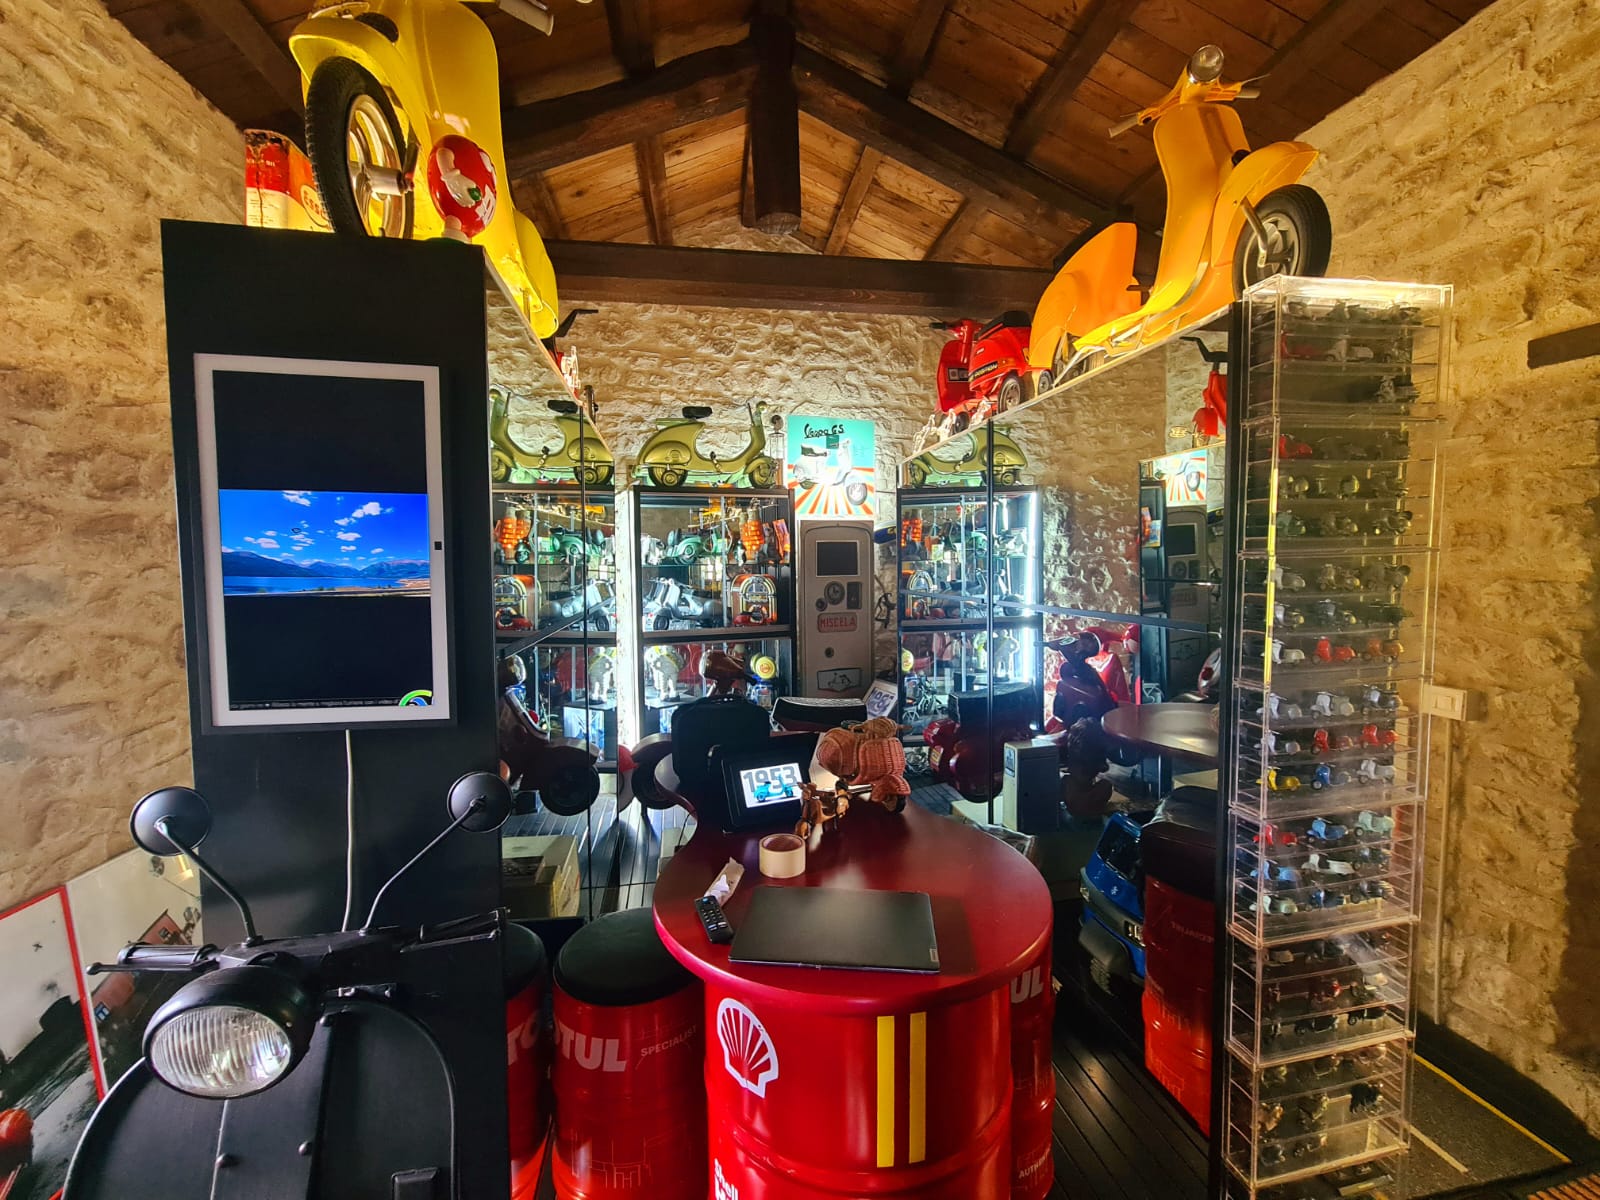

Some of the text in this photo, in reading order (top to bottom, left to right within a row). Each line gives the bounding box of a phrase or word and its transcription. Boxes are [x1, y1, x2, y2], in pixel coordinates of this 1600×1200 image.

[804, 423, 845, 439] Vespa GS
[743, 765, 798, 792] 1953
[1011, 966, 1044, 1004] UL
[640, 1024, 697, 1057] SPECIALIST
